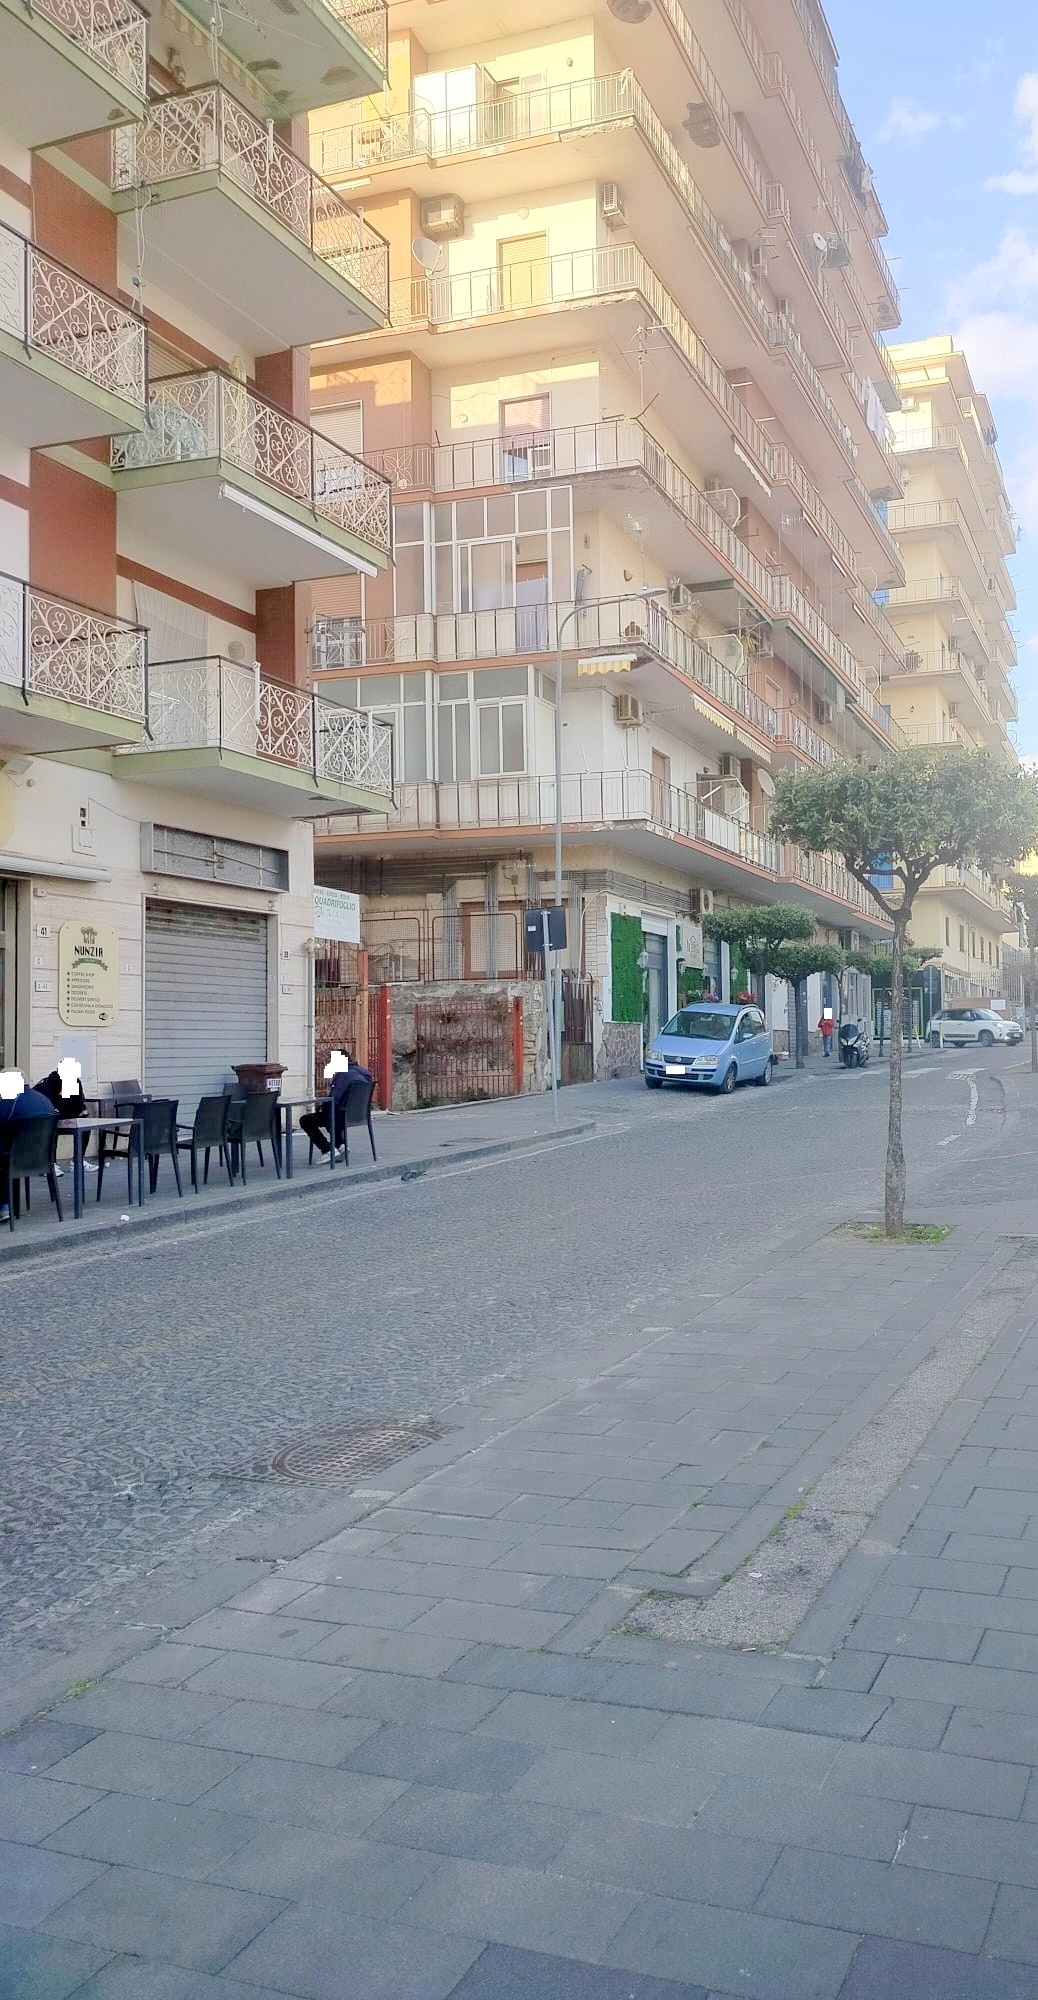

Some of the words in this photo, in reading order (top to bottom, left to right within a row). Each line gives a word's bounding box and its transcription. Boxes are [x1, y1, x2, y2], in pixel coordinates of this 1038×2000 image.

[314, 896, 356, 912] QUADRIFOGLIO
[40, 927, 47, 936] 41
[74, 945, 103, 957] NUNZIA
